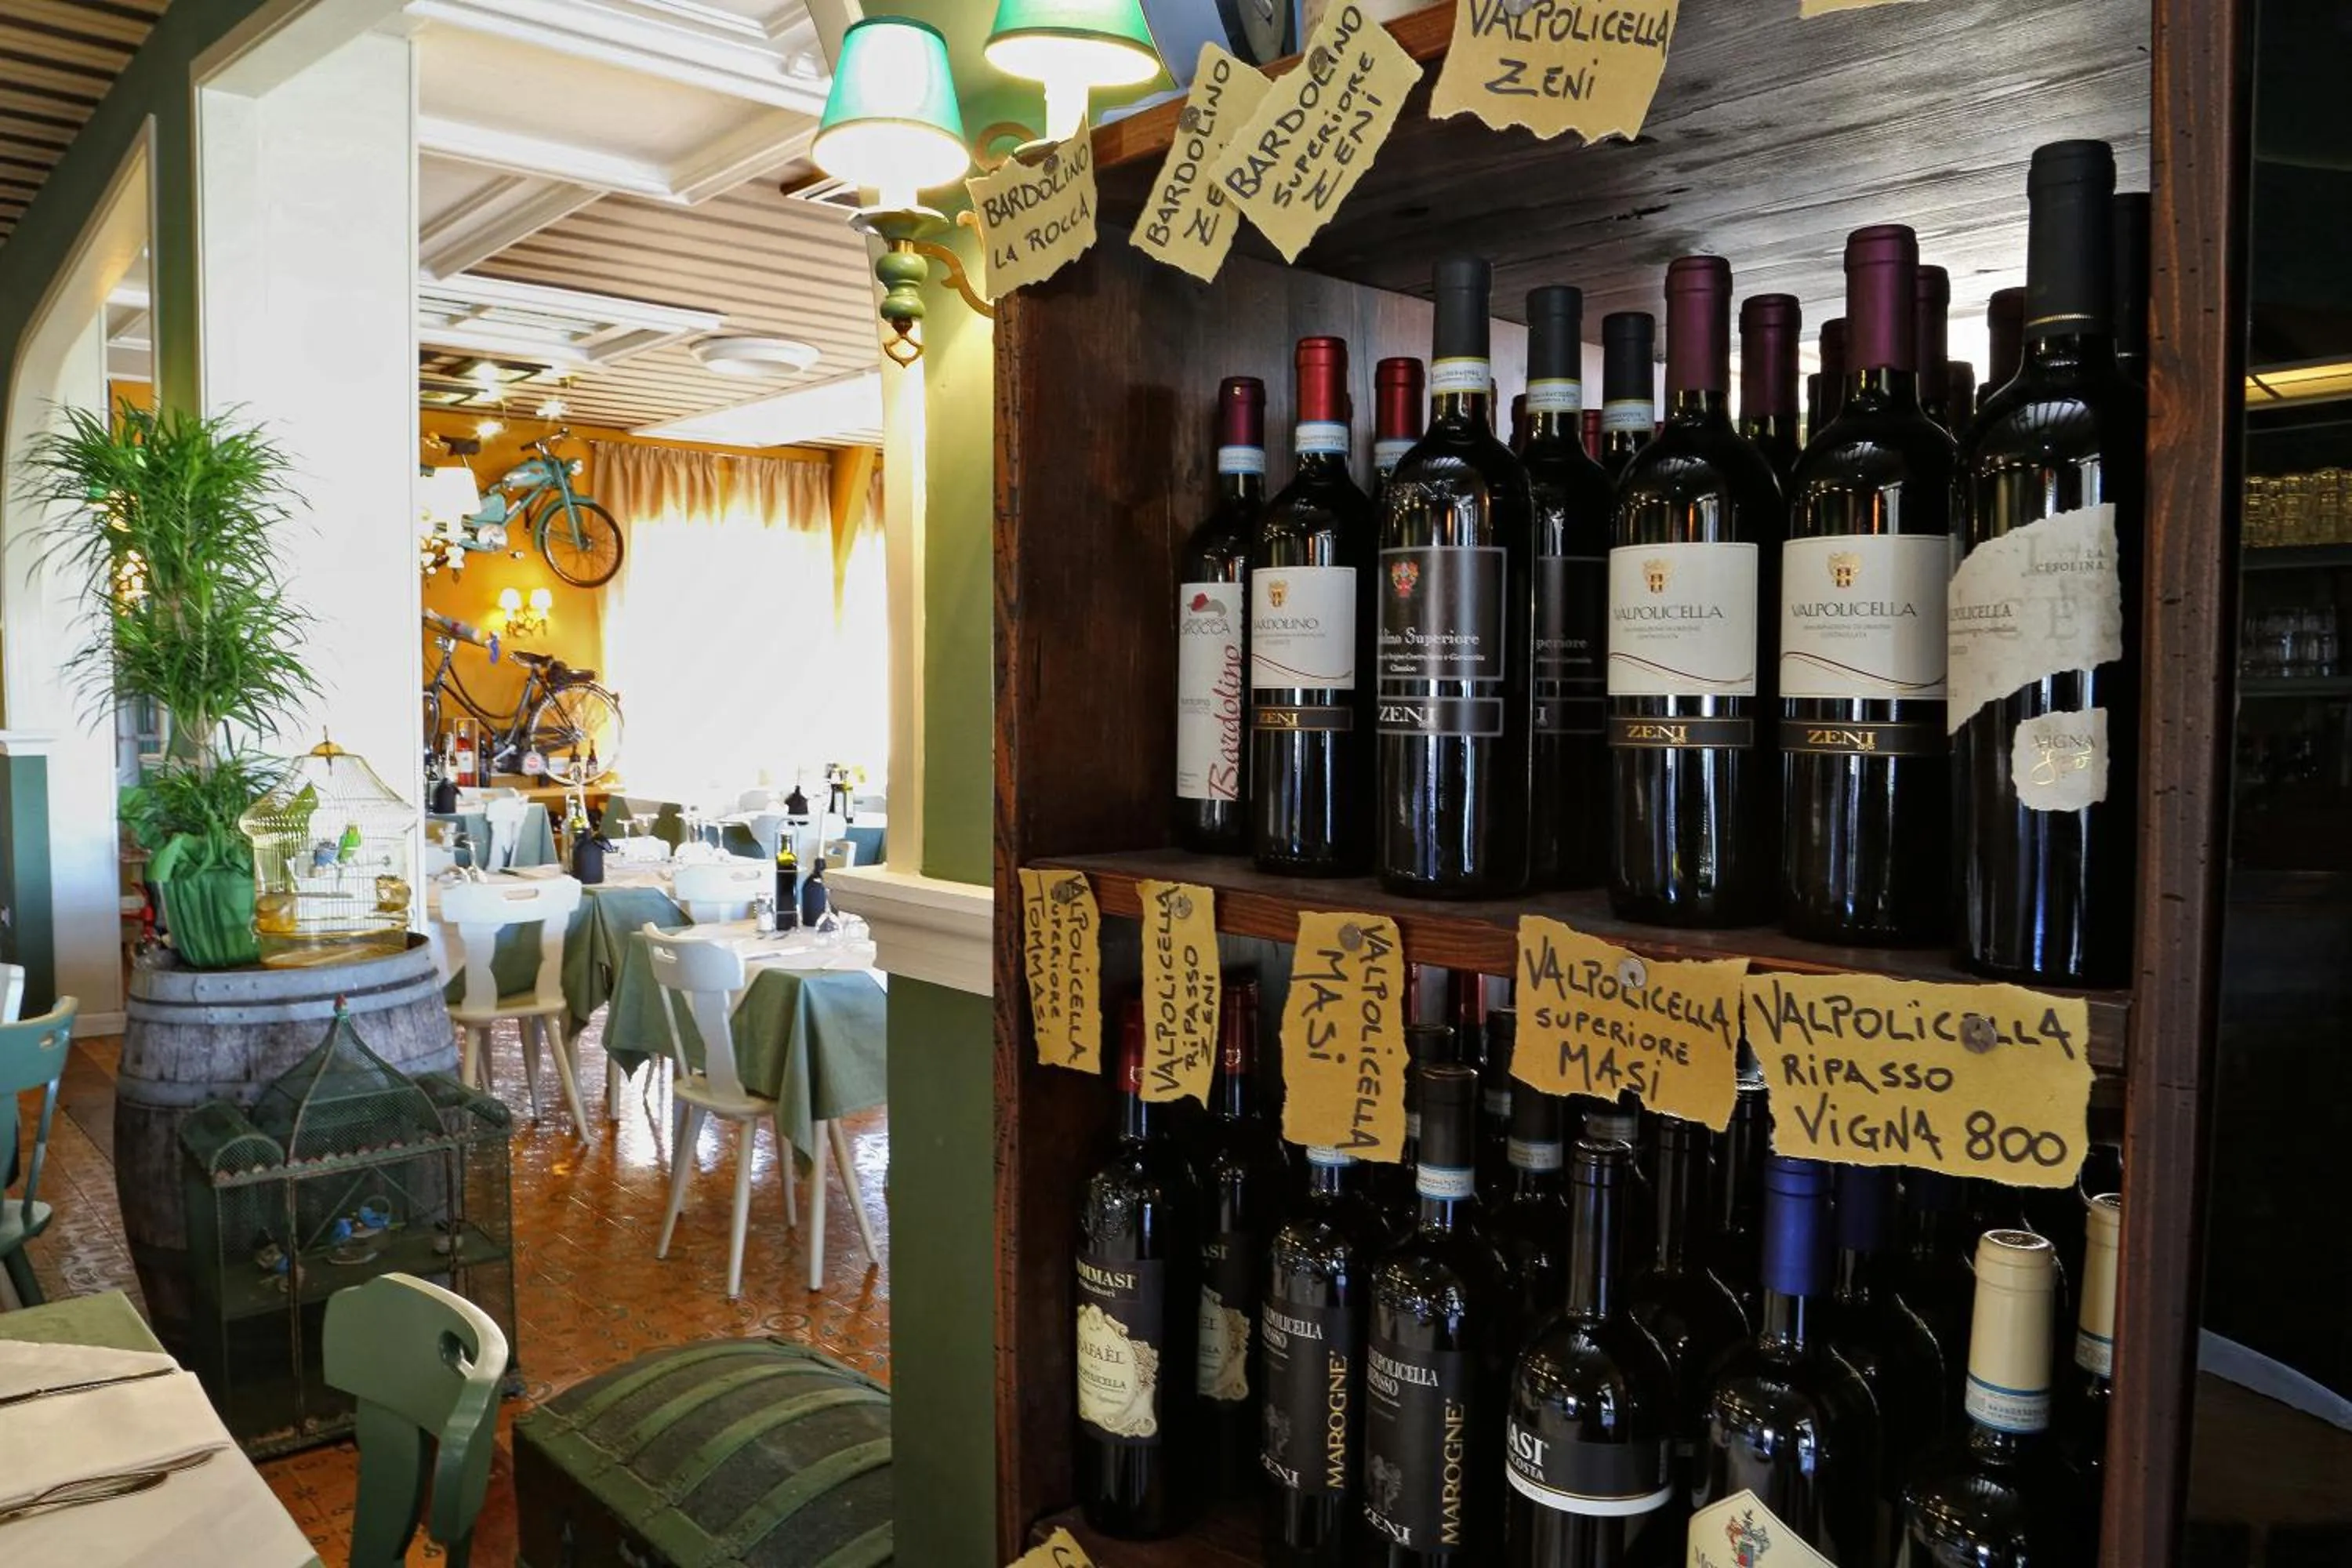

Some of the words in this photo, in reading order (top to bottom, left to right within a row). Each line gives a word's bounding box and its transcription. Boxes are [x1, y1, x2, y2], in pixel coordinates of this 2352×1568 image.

[994, 245, 1018, 269] LA
[1025, 193, 1090, 251] ROCCA
[1791, 601, 1918, 617] VALPOLICELLA
[1626, 725, 1689, 741] ZENI
[1807, 730, 1877, 746] ZENI
[1965, 1110, 2068, 1167] 800
[1508, 1421, 1544, 1467] ASI
